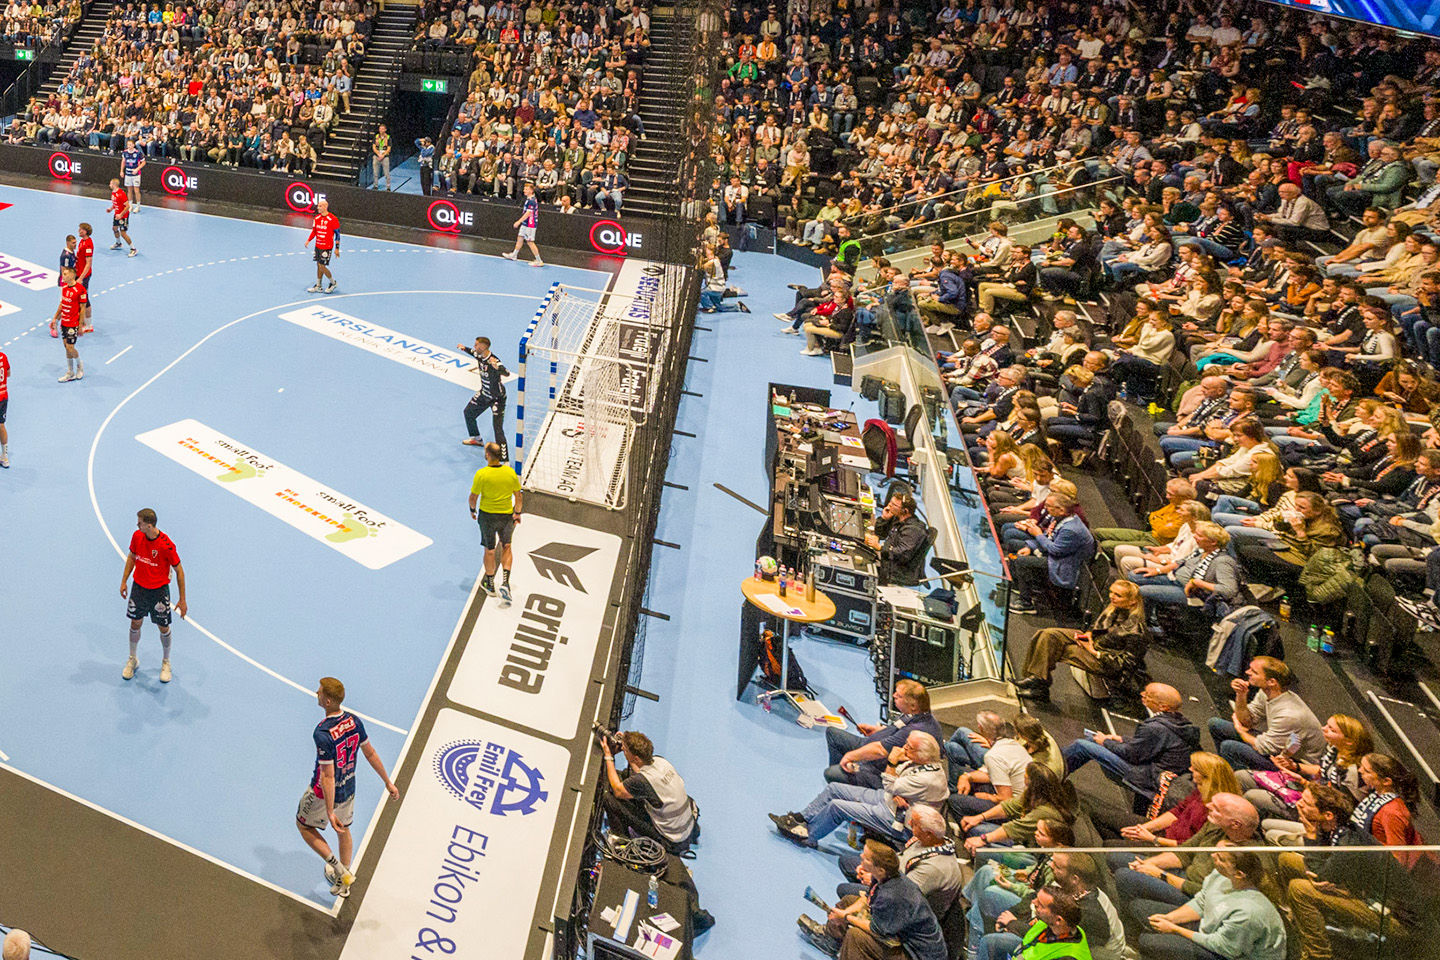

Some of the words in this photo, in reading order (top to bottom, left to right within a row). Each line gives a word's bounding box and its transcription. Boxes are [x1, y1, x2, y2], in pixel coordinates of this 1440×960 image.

[311, 310, 471, 368] HIRSLANDEN
[214, 439, 249, 457] small
[315, 491, 357, 511] small
[498, 592, 569, 695] erima
[335, 733, 360, 768] 57
[477, 741, 506, 777] Emil
[464, 774, 495, 811] Frey
[426, 824, 489, 923] Ebikon
[414, 926, 457, 955] &
